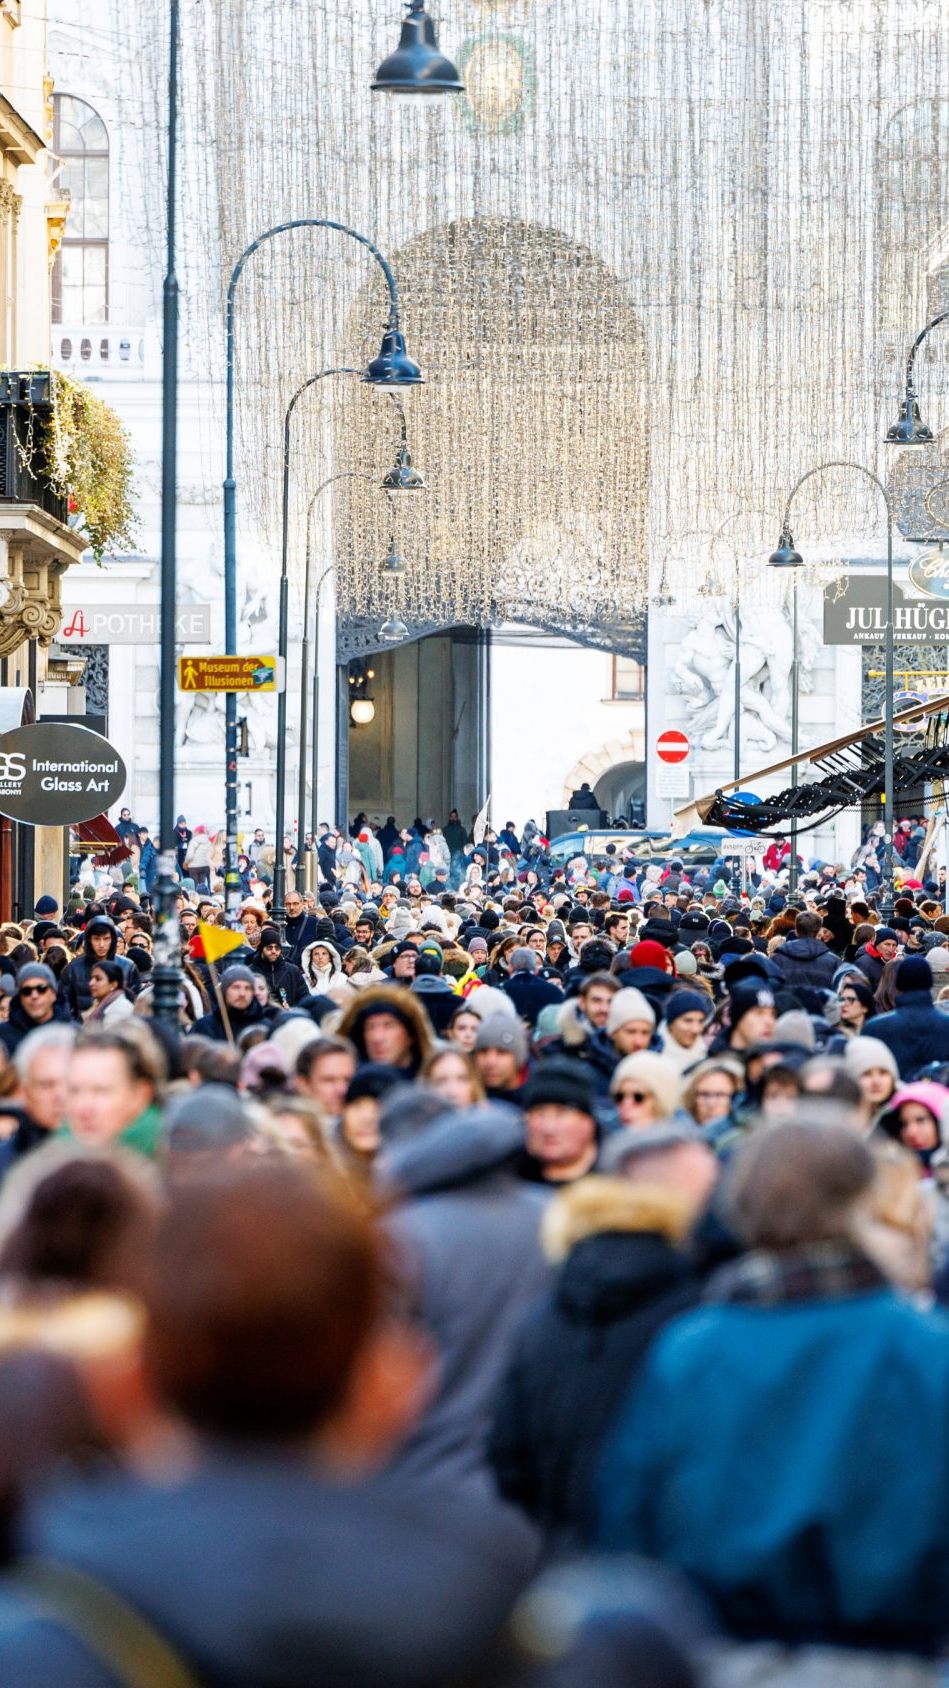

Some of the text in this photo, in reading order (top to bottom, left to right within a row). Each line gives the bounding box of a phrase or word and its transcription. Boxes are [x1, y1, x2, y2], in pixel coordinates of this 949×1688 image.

[63, 609, 204, 638] APOTHKE
[845, 602, 949, 630] JUL HÜG
[853, 632, 885, 640] ANKAUF
[198, 661, 260, 673] Museum der
[204, 674, 255, 687] Illusionen
[32, 758, 119, 773] International
[40, 776, 110, 793] Glass Art
